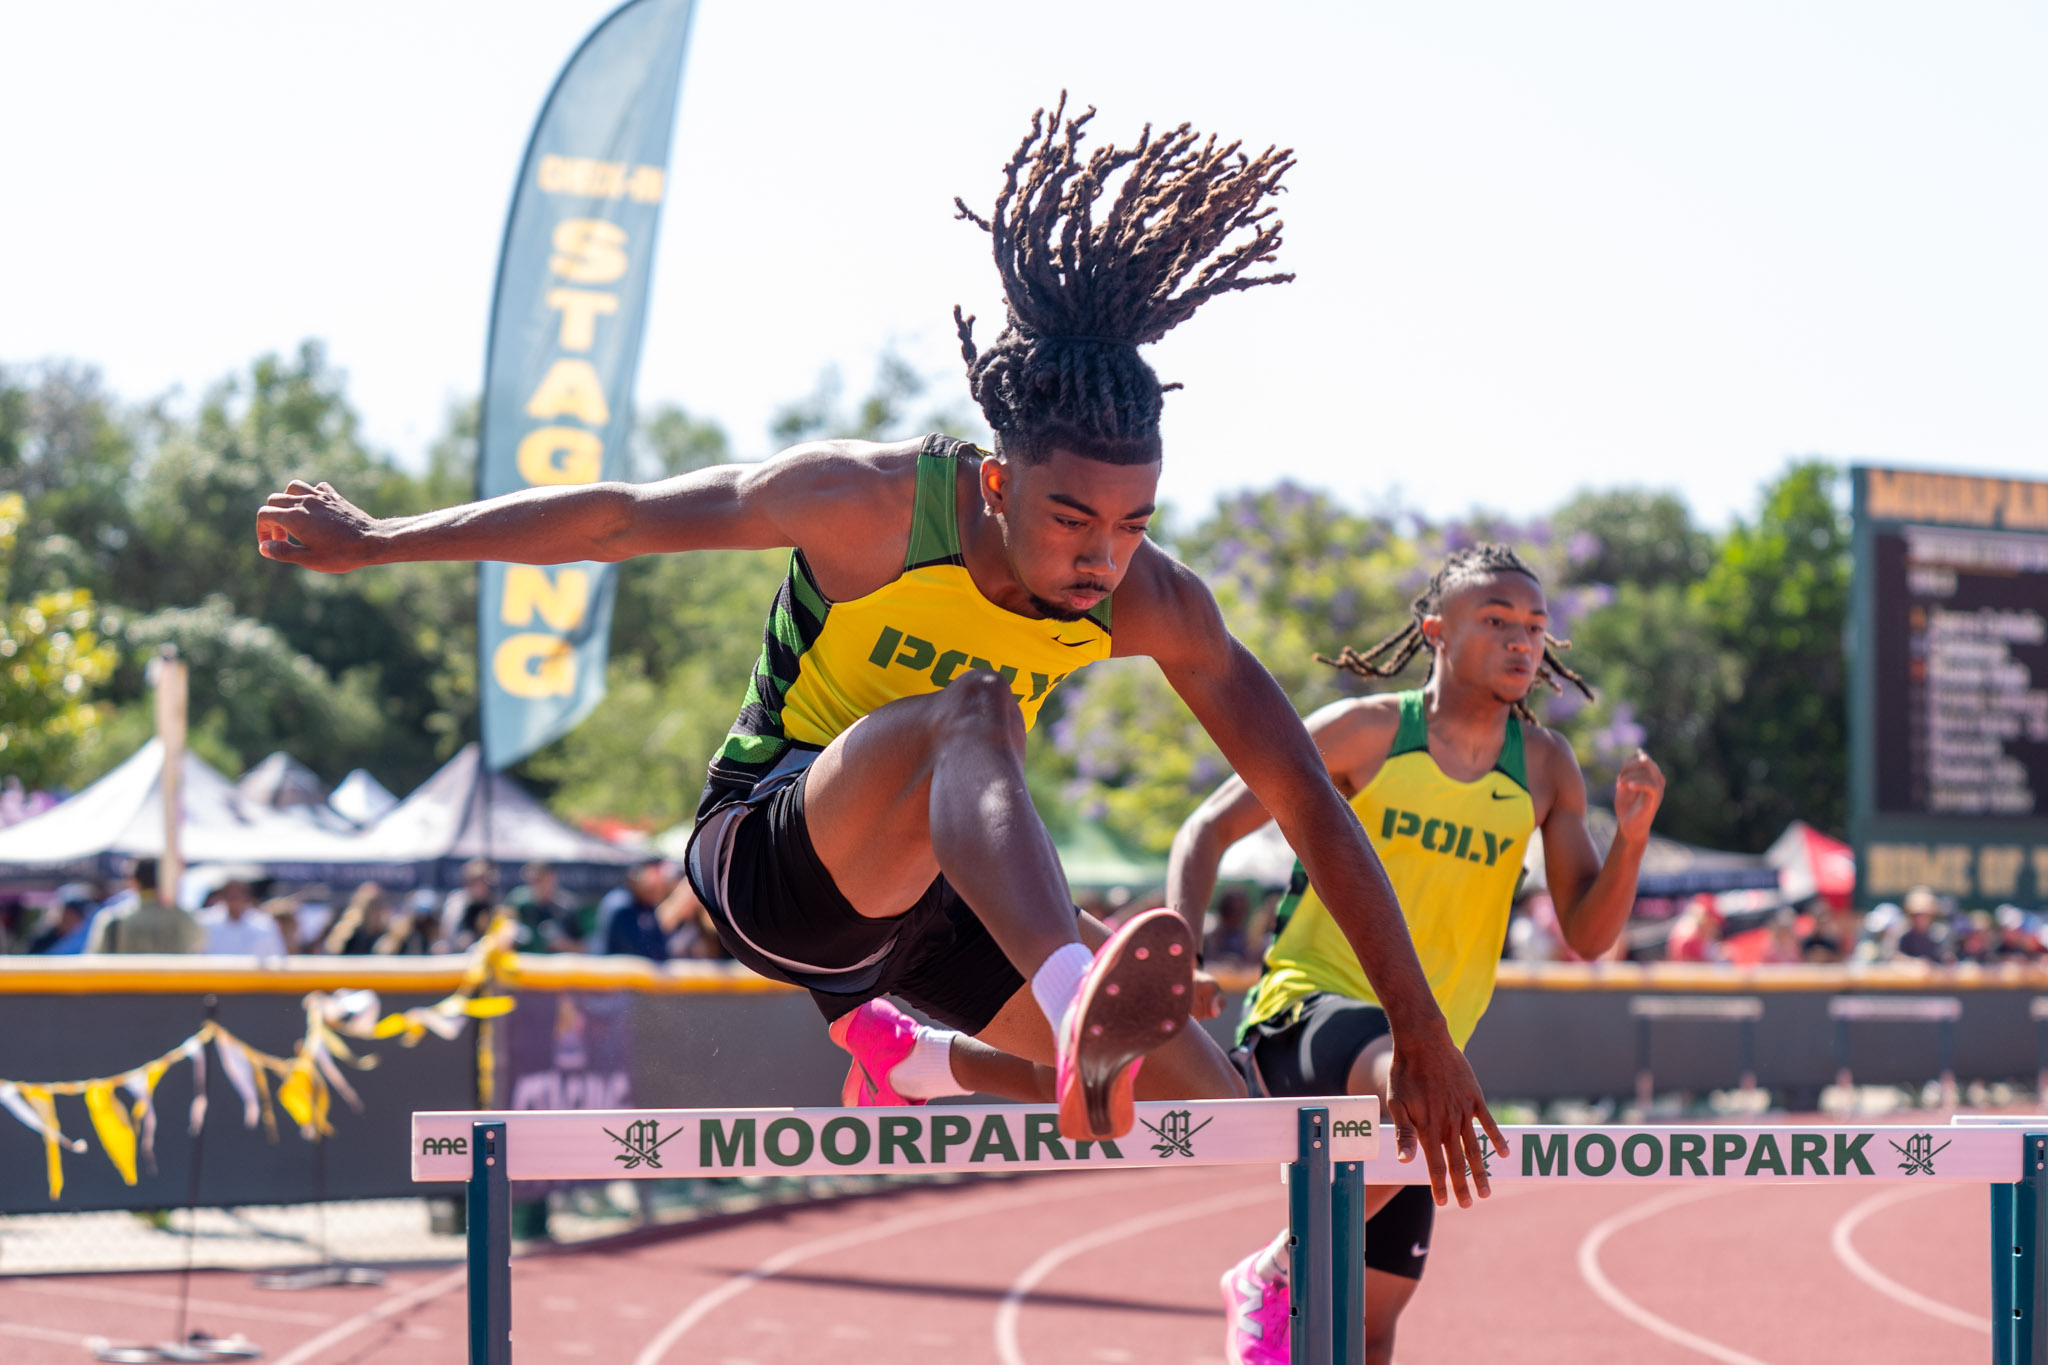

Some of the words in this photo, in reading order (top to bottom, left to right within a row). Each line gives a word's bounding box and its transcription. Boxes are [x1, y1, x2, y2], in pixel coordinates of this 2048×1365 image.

[493, 218, 628, 699] STAGNG
[1381, 806, 1515, 867] POLY
[1521, 1133, 1876, 1177] MOORPARK
